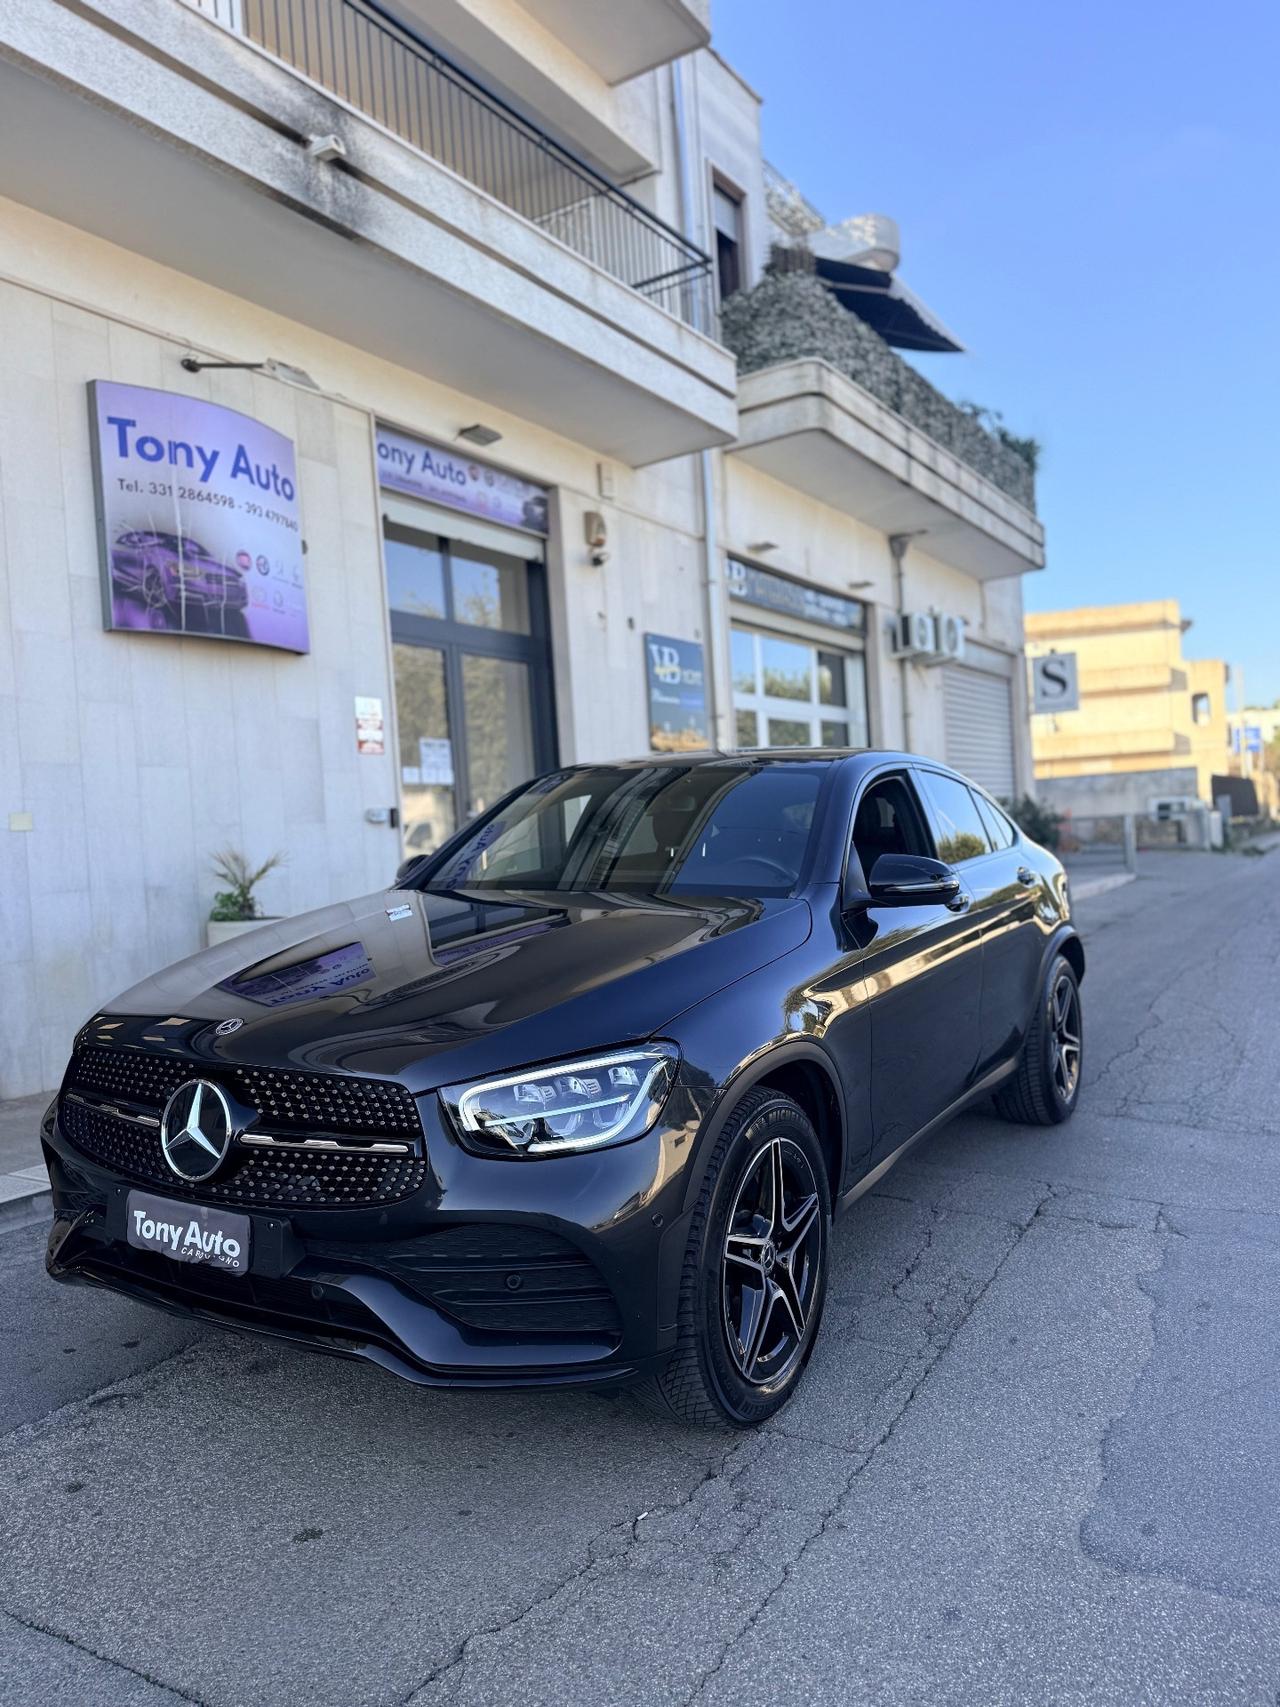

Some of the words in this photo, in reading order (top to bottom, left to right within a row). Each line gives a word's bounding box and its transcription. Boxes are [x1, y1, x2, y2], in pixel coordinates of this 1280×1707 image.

[107, 416, 220, 483] Tony
[230, 443, 295, 501] Auto
[377, 443, 415, 475] ony
[422, 449, 466, 485] Auto
[117, 478, 144, 493] Tel.
[149, 481, 173, 497] 331
[178, 486, 235, 509] 2864598
[1041, 658, 1068, 698] S
[133, 1210, 184, 1251] Tony
[183, 1220, 241, 1258] Auto
[181, 1246, 240, 1268] CAROVGNO
